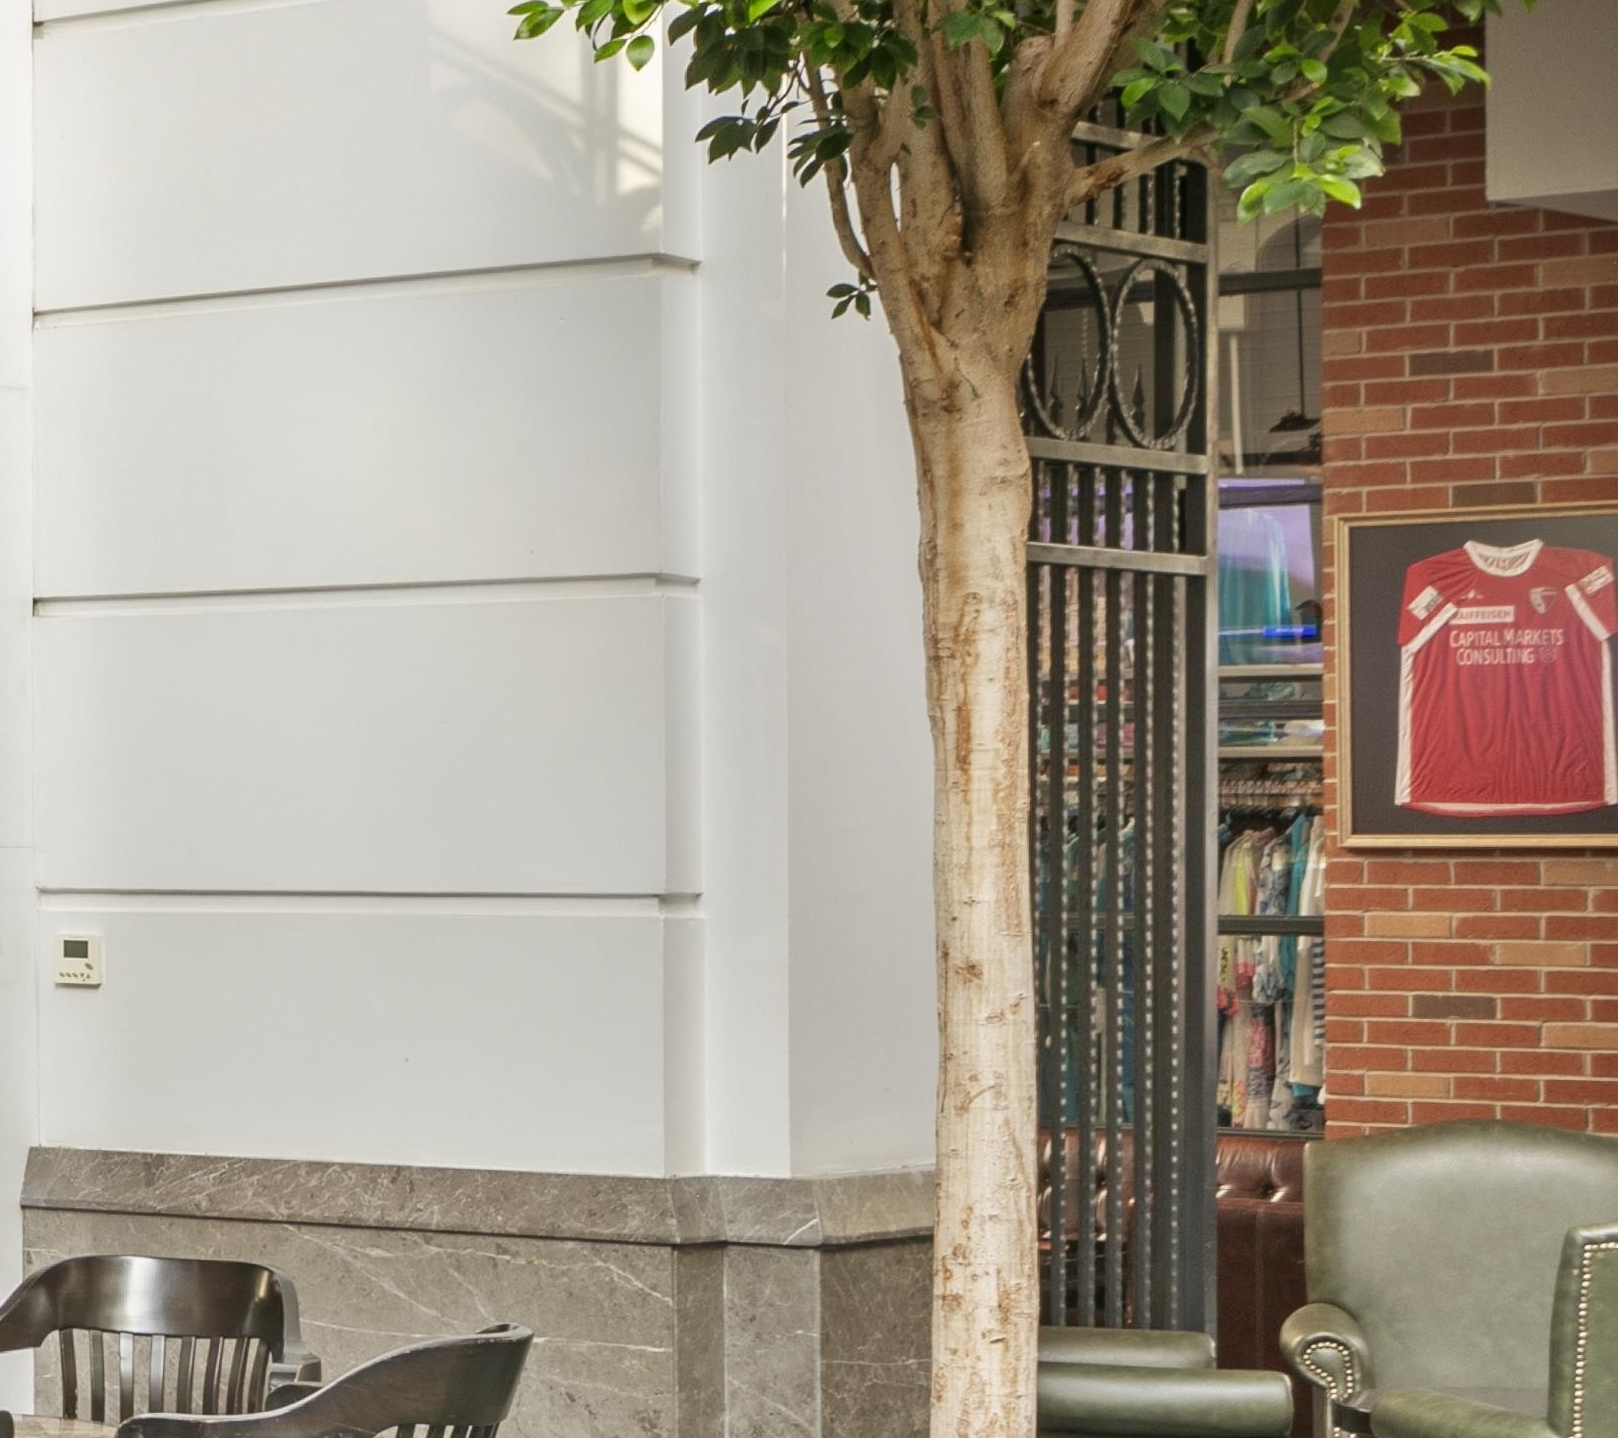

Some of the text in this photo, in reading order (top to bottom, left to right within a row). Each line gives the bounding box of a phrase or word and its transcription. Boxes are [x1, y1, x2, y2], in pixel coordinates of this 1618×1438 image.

[1449, 627, 1565, 648] CAPITAL MARKETS
[1456, 647, 1536, 666] CONSULTING
